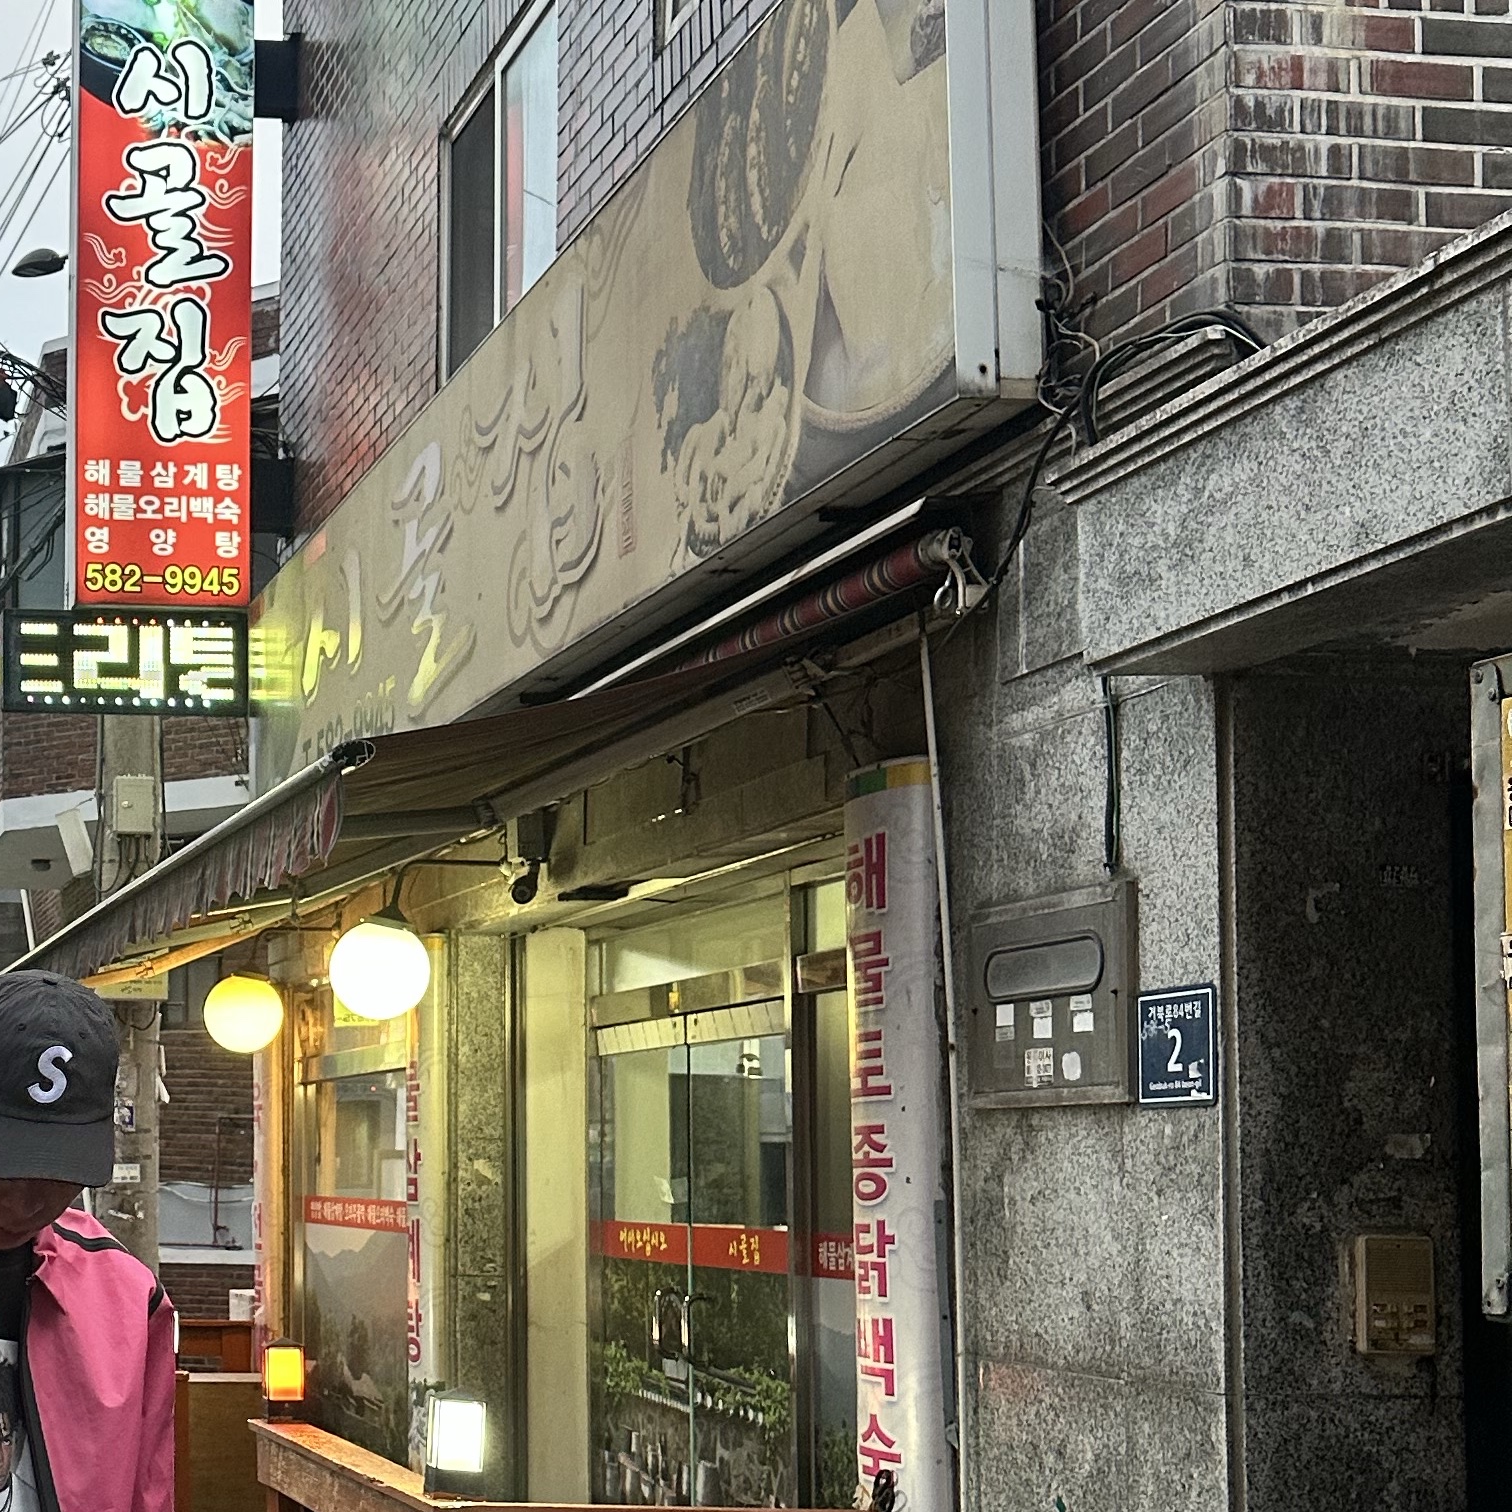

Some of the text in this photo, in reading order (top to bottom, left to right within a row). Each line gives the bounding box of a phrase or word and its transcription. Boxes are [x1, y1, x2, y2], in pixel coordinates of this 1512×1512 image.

[103, 39, 231, 445] 시골집
[84, 459, 241, 491] 해물삼계탕
[83, 493, 241, 525] 해물오리백숙
[84, 564, 241, 596] 582-9945
[1167, 1028, 1183, 1073] 2
[28, 1045, 73, 1104] S
[728, 1233, 761, 1266] 시골집
